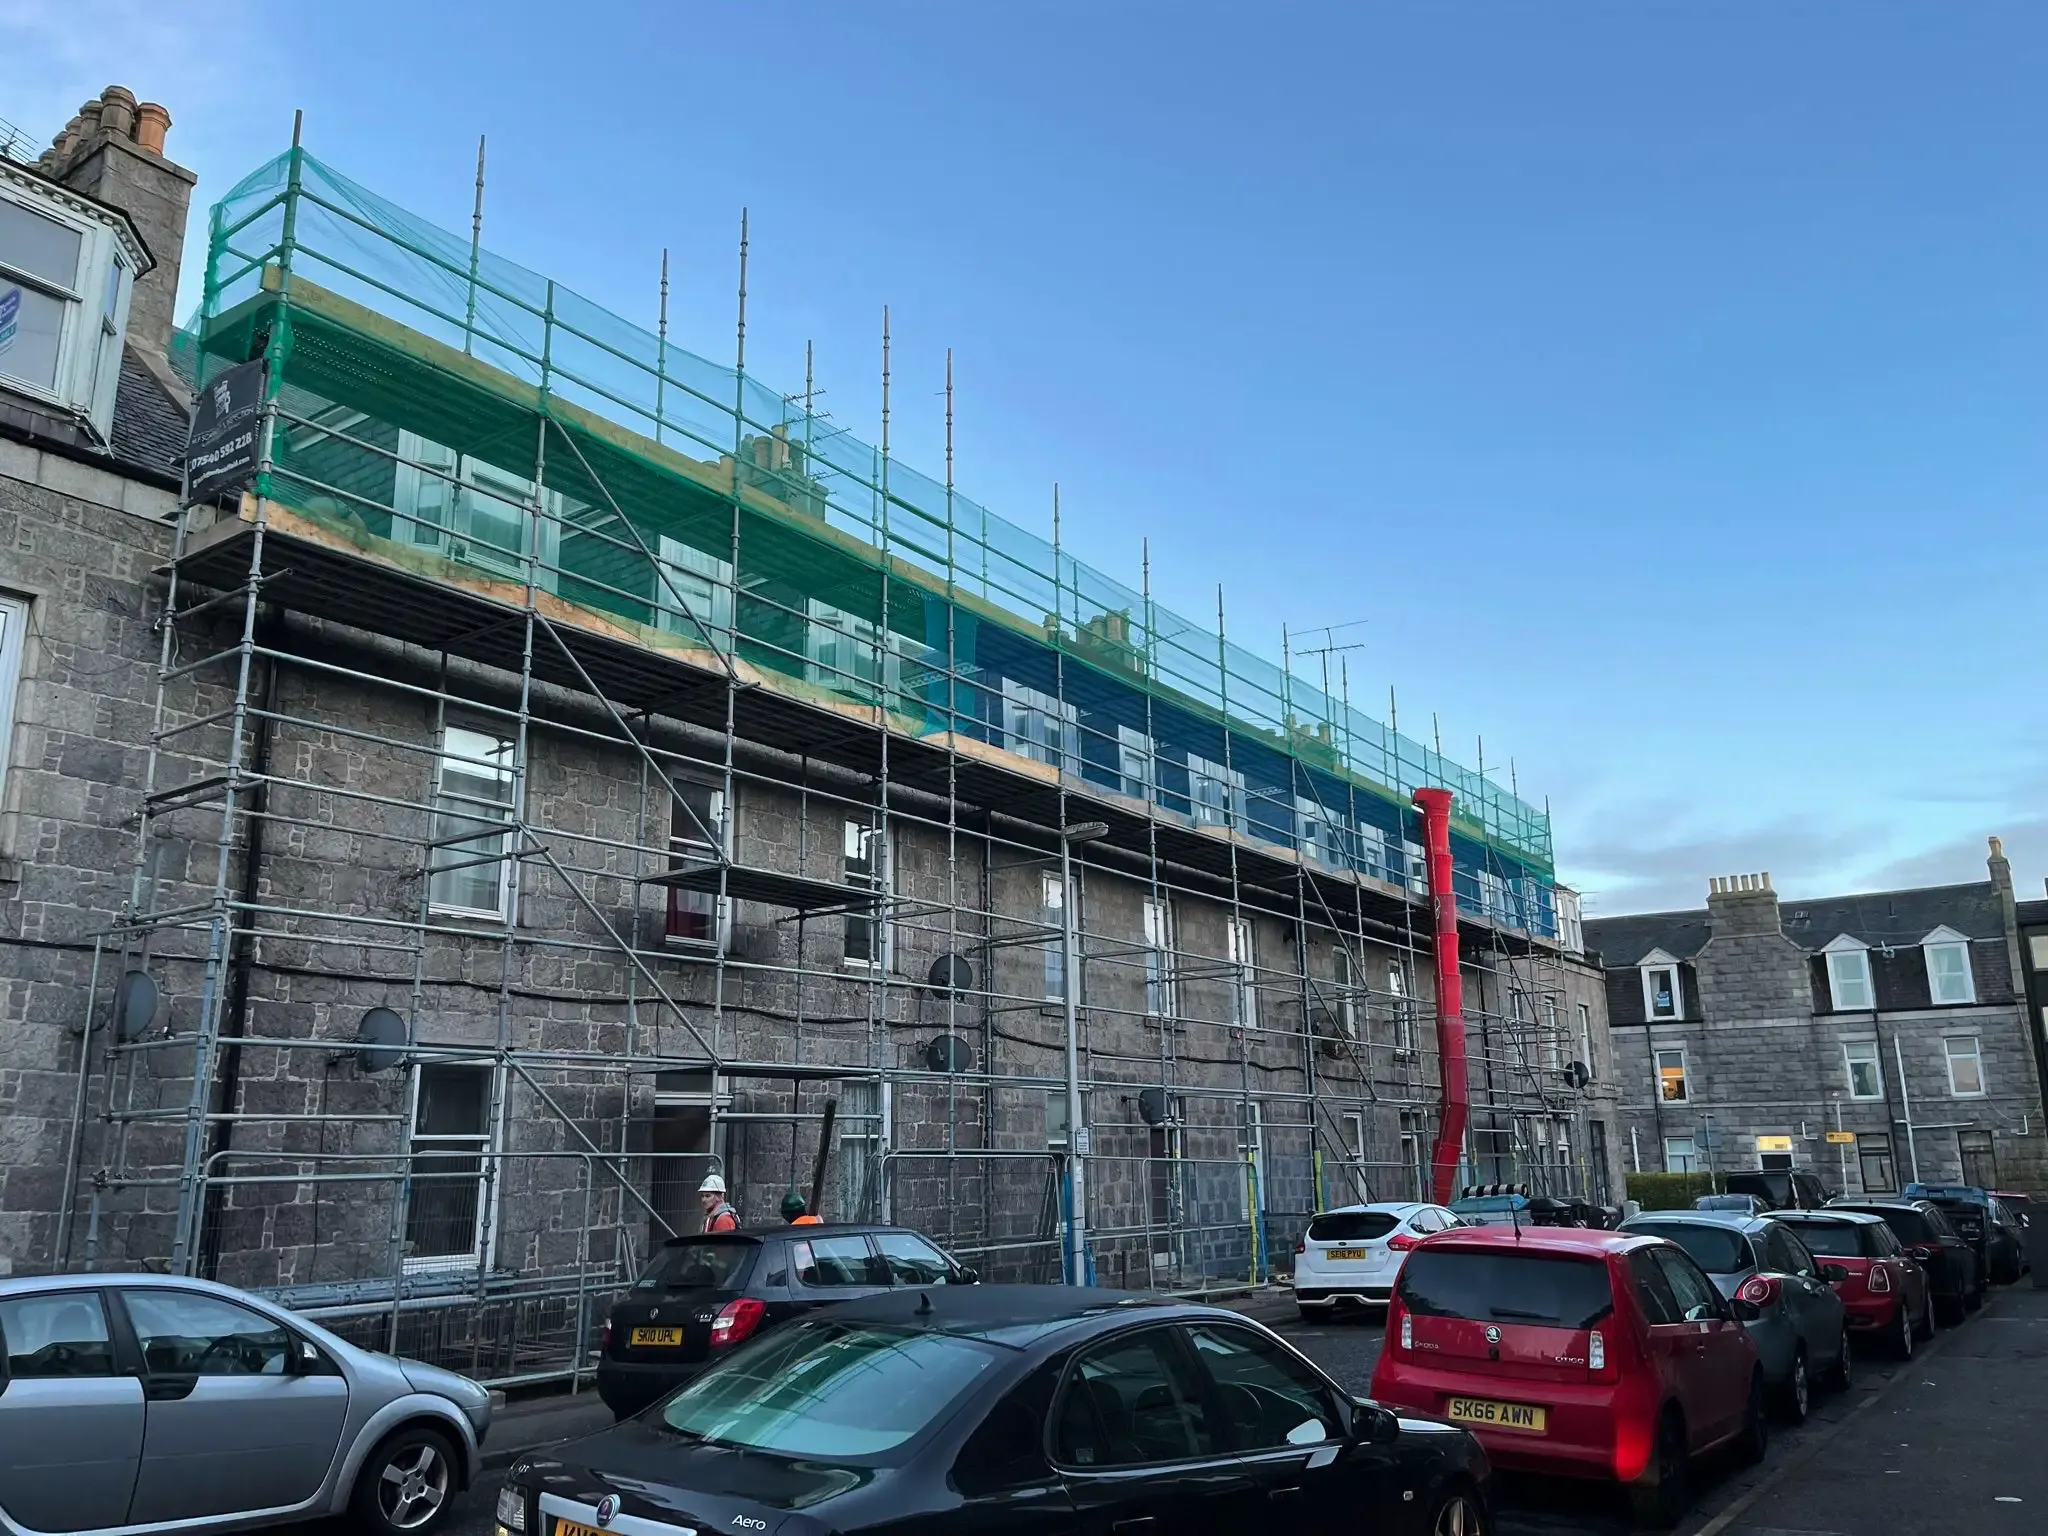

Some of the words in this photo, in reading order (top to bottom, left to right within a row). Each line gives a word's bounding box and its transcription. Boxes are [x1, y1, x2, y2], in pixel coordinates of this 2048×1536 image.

[220, 441, 234, 458] 592
[235, 432, 252, 449] 228
[637, 1329, 656, 1342] SK10
[657, 1329, 676, 1343] UPL
[1452, 1401, 1495, 1420] SK66
[1500, 1406, 1534, 1426] AWN
[731, 1514, 767, 1530] Aero
